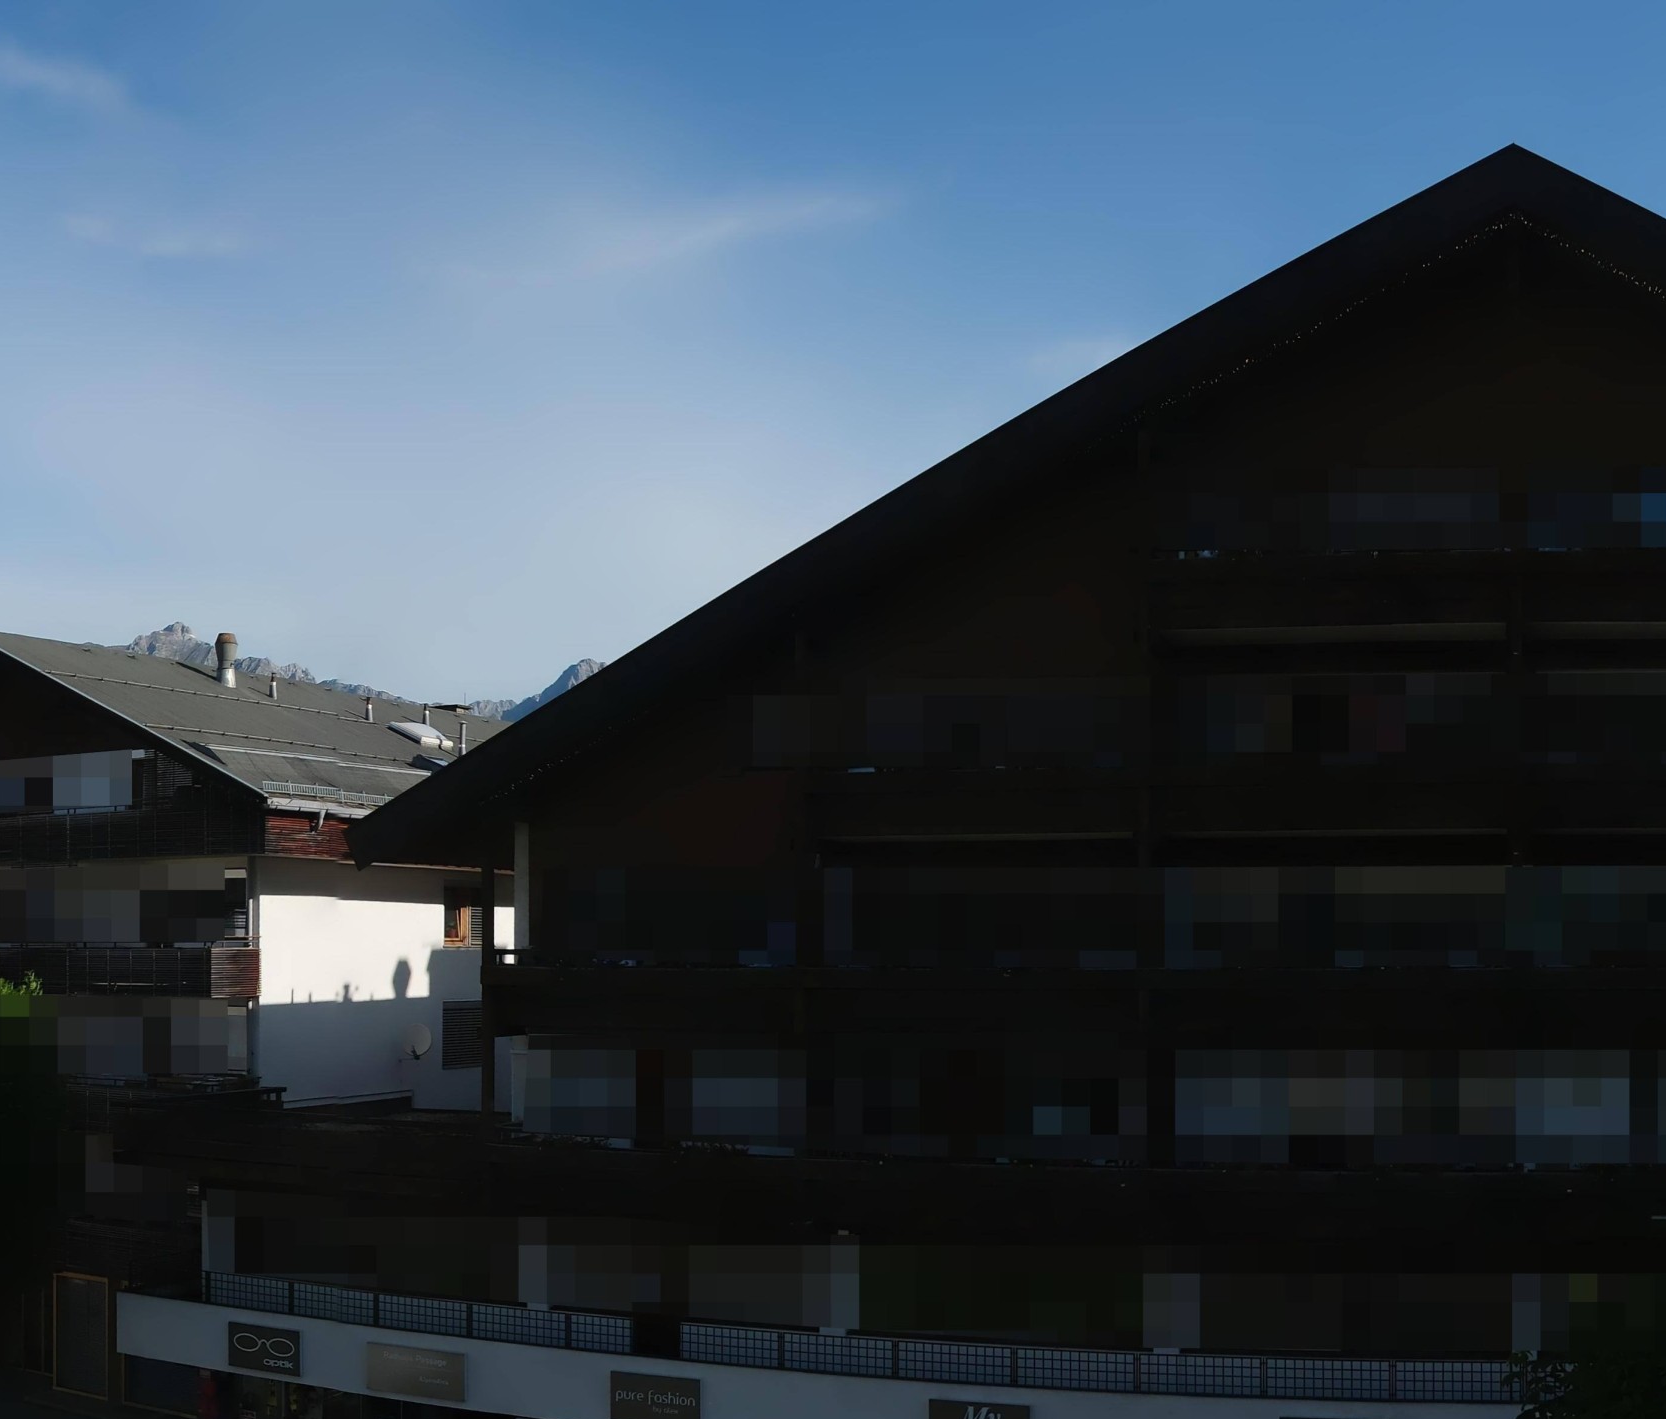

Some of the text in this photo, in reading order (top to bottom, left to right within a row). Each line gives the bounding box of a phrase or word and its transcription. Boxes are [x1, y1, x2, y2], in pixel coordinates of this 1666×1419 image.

[263, 1358, 294, 1369] optik
[615, 1389, 696, 1407] pure fashion
